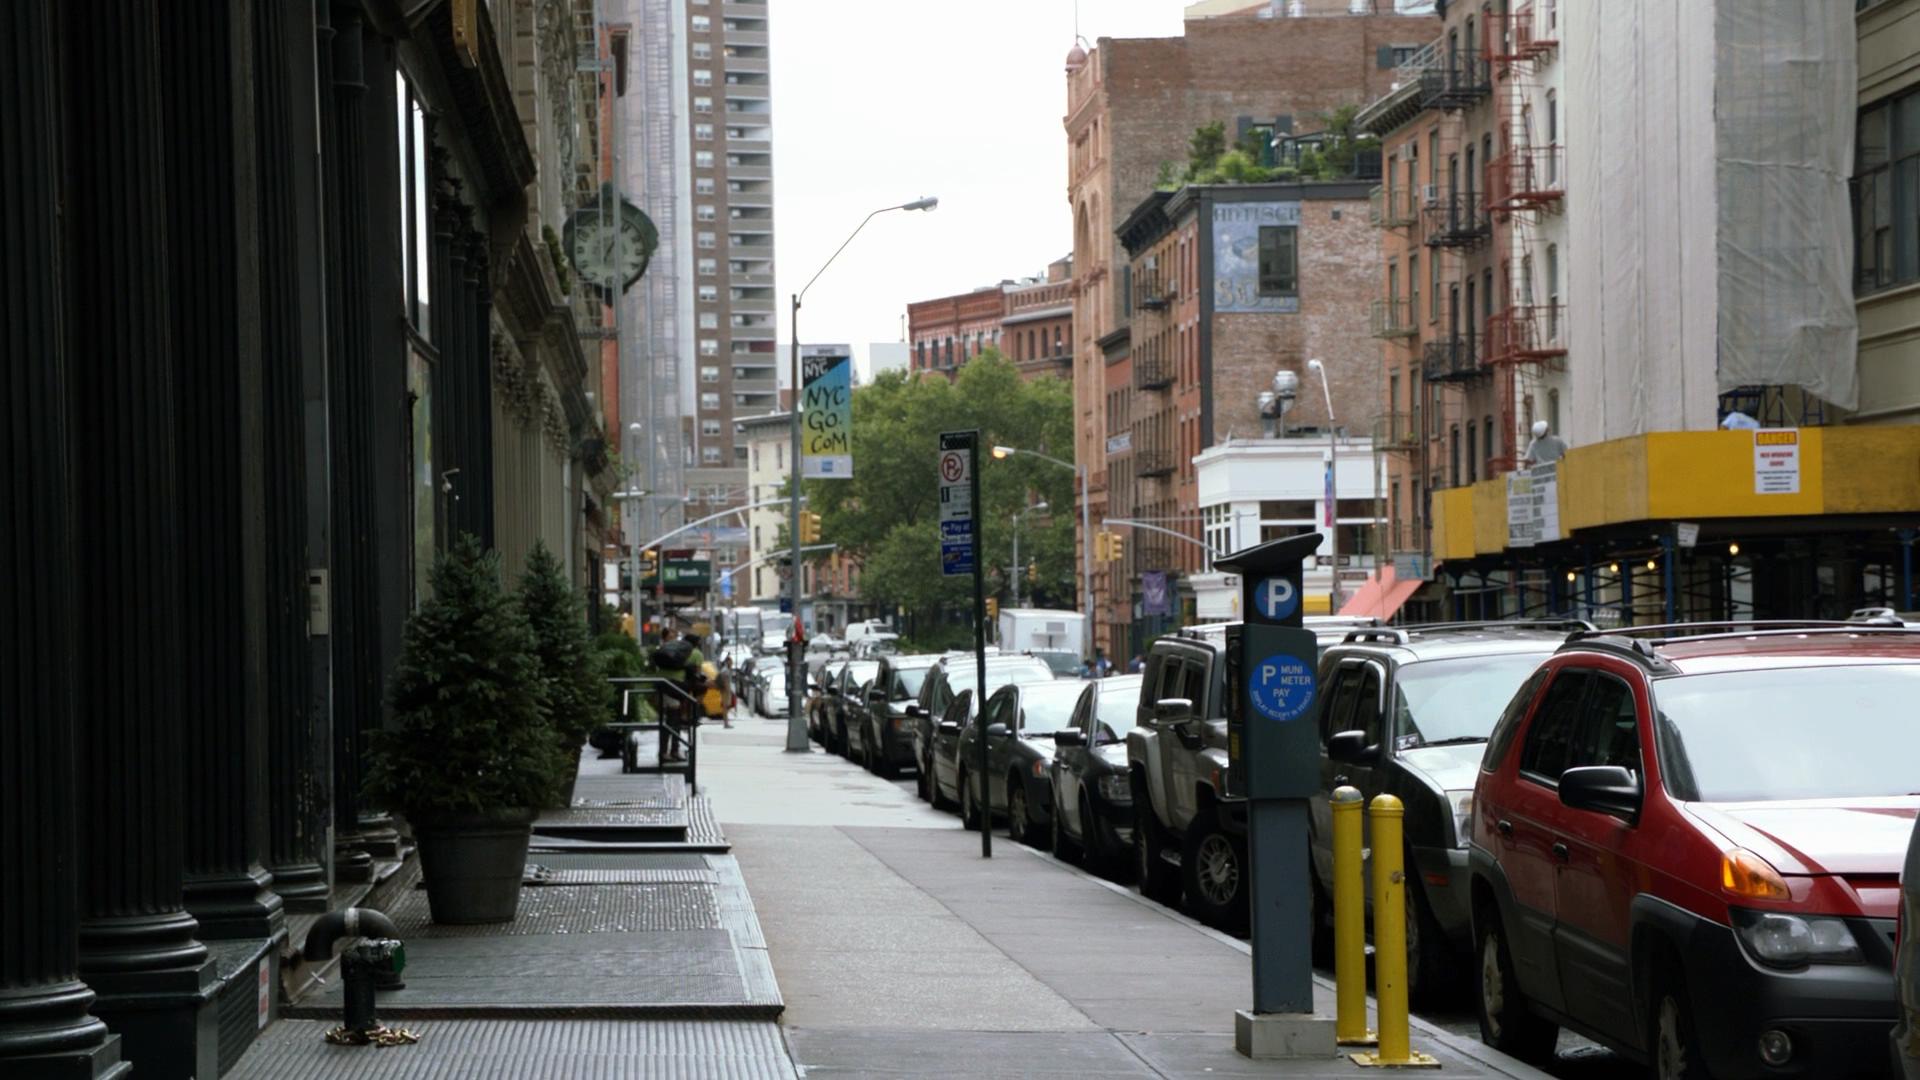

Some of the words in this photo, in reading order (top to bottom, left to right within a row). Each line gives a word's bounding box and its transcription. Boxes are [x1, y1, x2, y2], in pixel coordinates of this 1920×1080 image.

[804, 363, 828, 378] NYC
[806, 386, 845, 410] NYC
[1267, 578, 1293, 617] P
[1262, 664, 1277, 686] P
[1280, 665, 1304, 674] MUNI
[1280, 675, 1312, 686] METER
[1272, 688, 1291, 697] PAY
